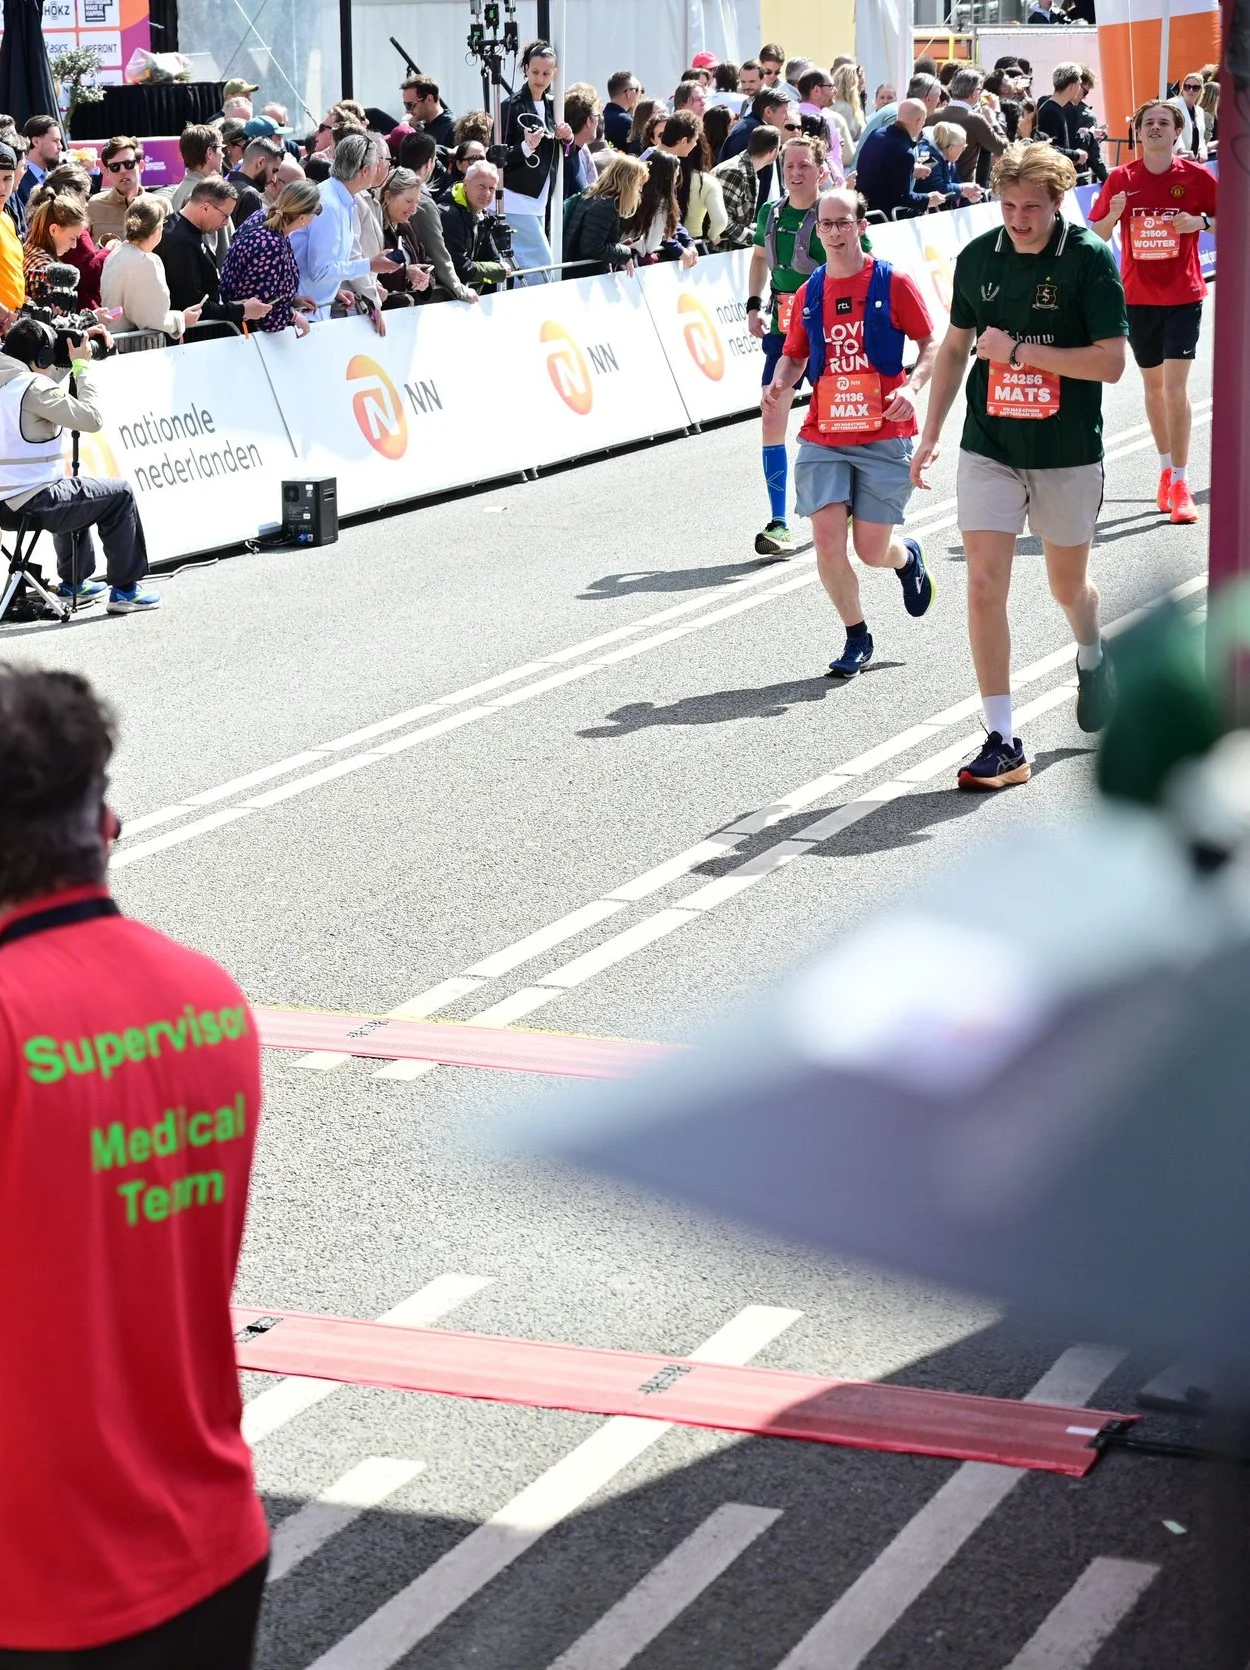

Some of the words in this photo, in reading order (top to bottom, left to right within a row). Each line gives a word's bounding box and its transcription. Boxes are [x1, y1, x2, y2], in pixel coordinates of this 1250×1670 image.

[1134, 240, 1175, 248] WOUTER
[716, 298, 747, 324] natio
[586, 342, 620, 375] NN
[832, 339, 859, 356] TO
[830, 353, 869, 373] RUN
[1003, 373, 1043, 385] 24256
[403, 379, 443, 415] NN
[834, 393, 864, 402] 21136
[994, 386, 1051, 403] MATS
[830, 404, 869, 417] MAX
[118, 402, 215, 449] nationale
[134, 440, 263, 491] nederlanden
[23, 1003, 248, 1084] Supervisor
[91, 1092, 245, 1174] Medical
